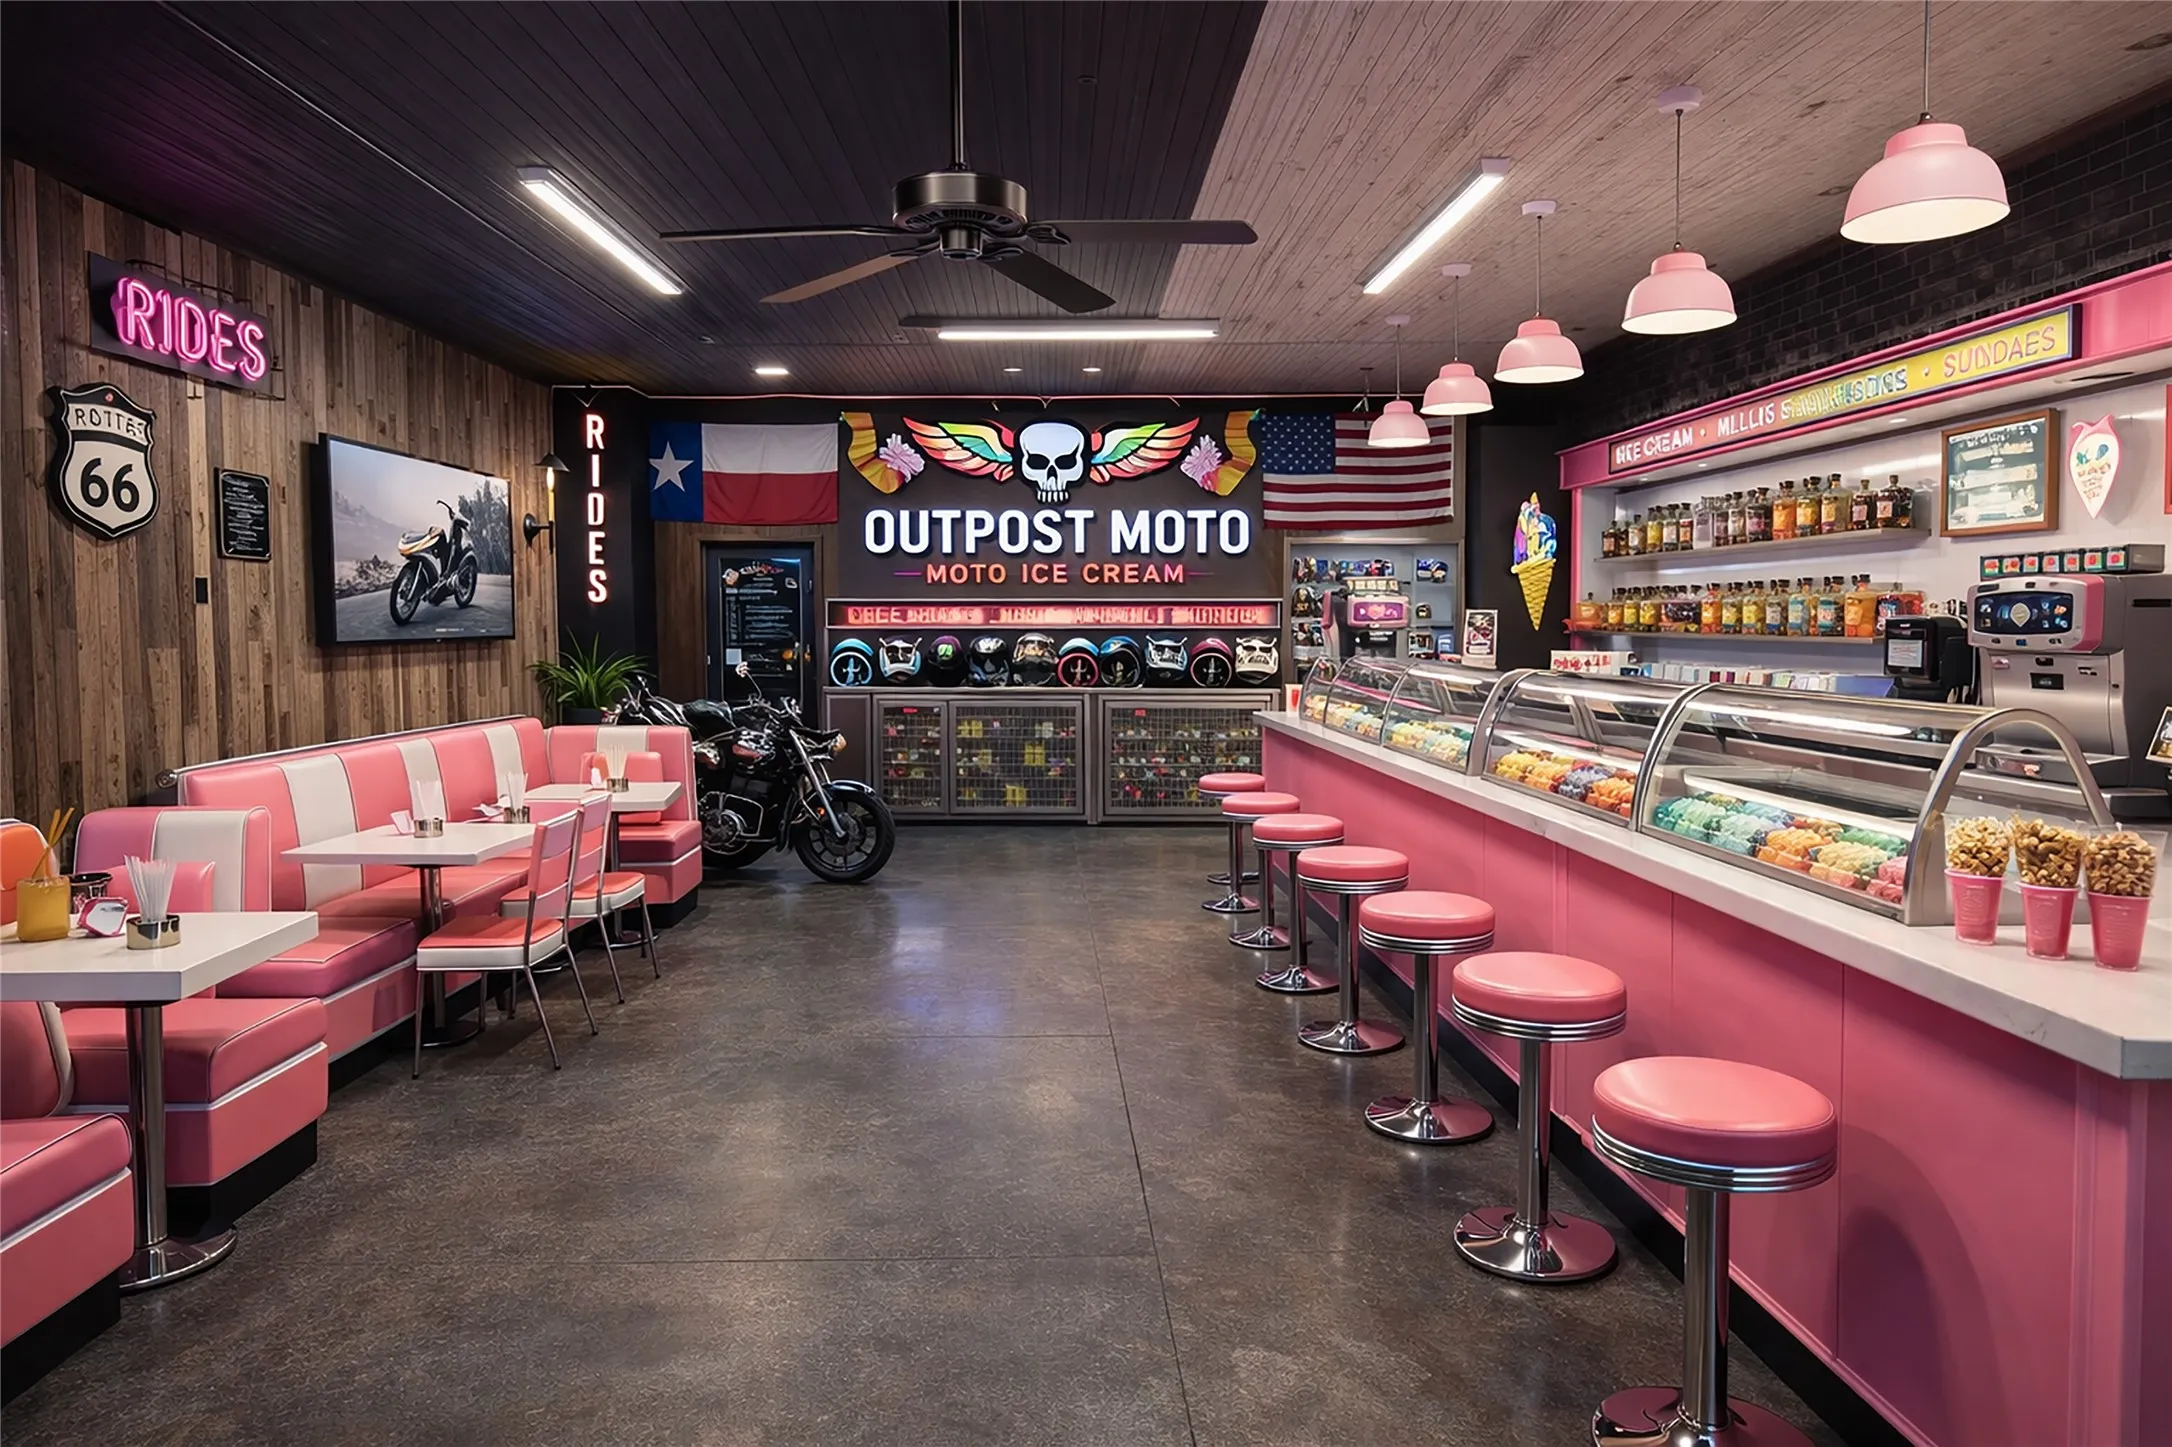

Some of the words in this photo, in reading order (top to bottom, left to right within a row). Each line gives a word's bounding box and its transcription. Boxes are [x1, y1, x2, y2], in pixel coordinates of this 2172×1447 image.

[115, 277, 267, 381] RIDES
[1943, 325, 2056, 378] SUNDAES
[80, 457, 140, 513] 66
[585, 413, 608, 604] RIDES
[864, 508, 1094, 555] OUTPOST
[1111, 508, 1250, 555] MOTO
[926, 563, 1007, 585] MOTO
[1021, 563, 1068, 585] ICE
[1082, 563, 1185, 585] CREAM
